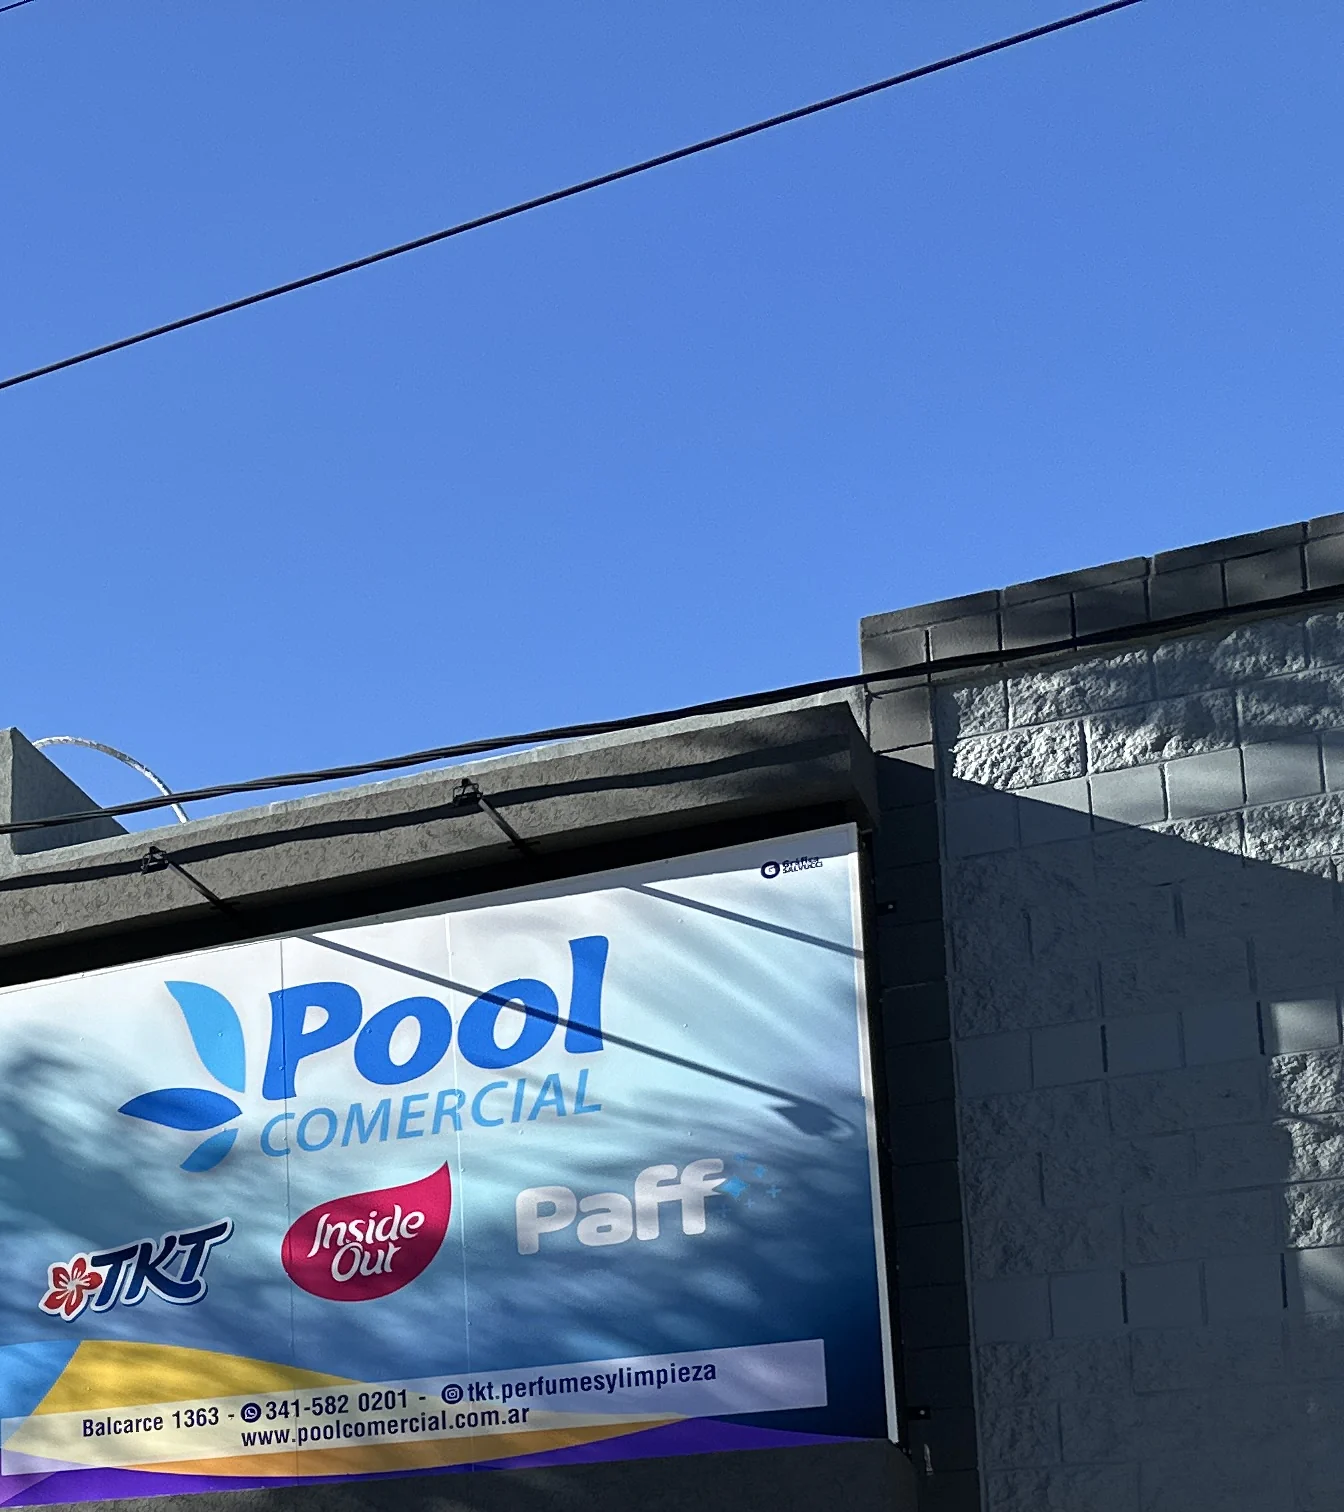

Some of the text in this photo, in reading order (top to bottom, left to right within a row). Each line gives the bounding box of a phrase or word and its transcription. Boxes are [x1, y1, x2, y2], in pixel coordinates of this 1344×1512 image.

[262, 935, 609, 1101] Pool
[260, 1068, 603, 1157] COMERCIAL
[306, 1208, 425, 1258] Inside
[515, 1158, 729, 1256] Paff
[86, 1220, 231, 1308] TKT
[330, 1240, 402, 1284] Out
[81, 1413, 164, 1438] Balcarce
[171, 1406, 220, 1430] 1363
[264, 1393, 350, 1421] 341-582
[357, 1388, 409, 1413] 0201
[467, 1362, 717, 1403] tkt.perfumesylimpieza
[240, 1405, 531, 1448] www.poolcomercial.com.ar
